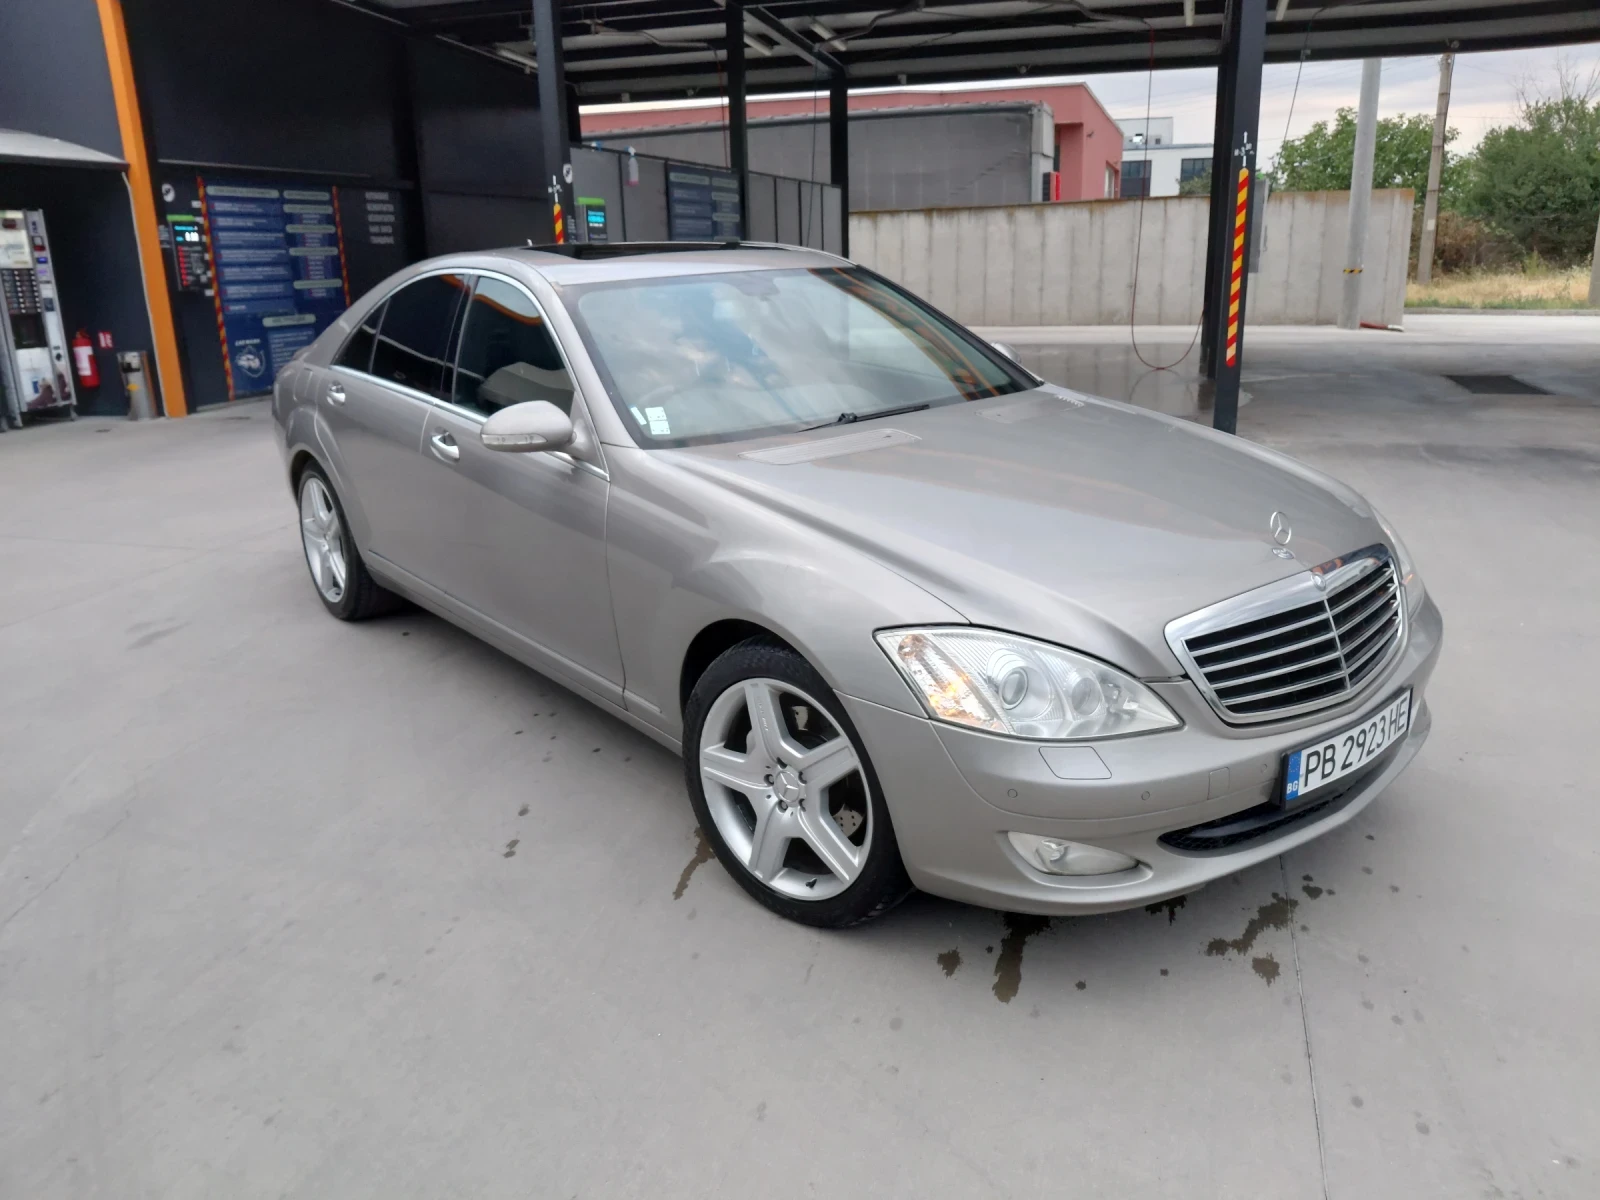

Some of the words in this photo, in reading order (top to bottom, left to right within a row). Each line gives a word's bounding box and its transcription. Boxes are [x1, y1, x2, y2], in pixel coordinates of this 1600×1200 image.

[1304, 743, 1337, 788] PB
[1340, 715, 1386, 772] 2923
[1388, 697, 1408, 741] HE
[1286, 780, 1299, 794] BG
